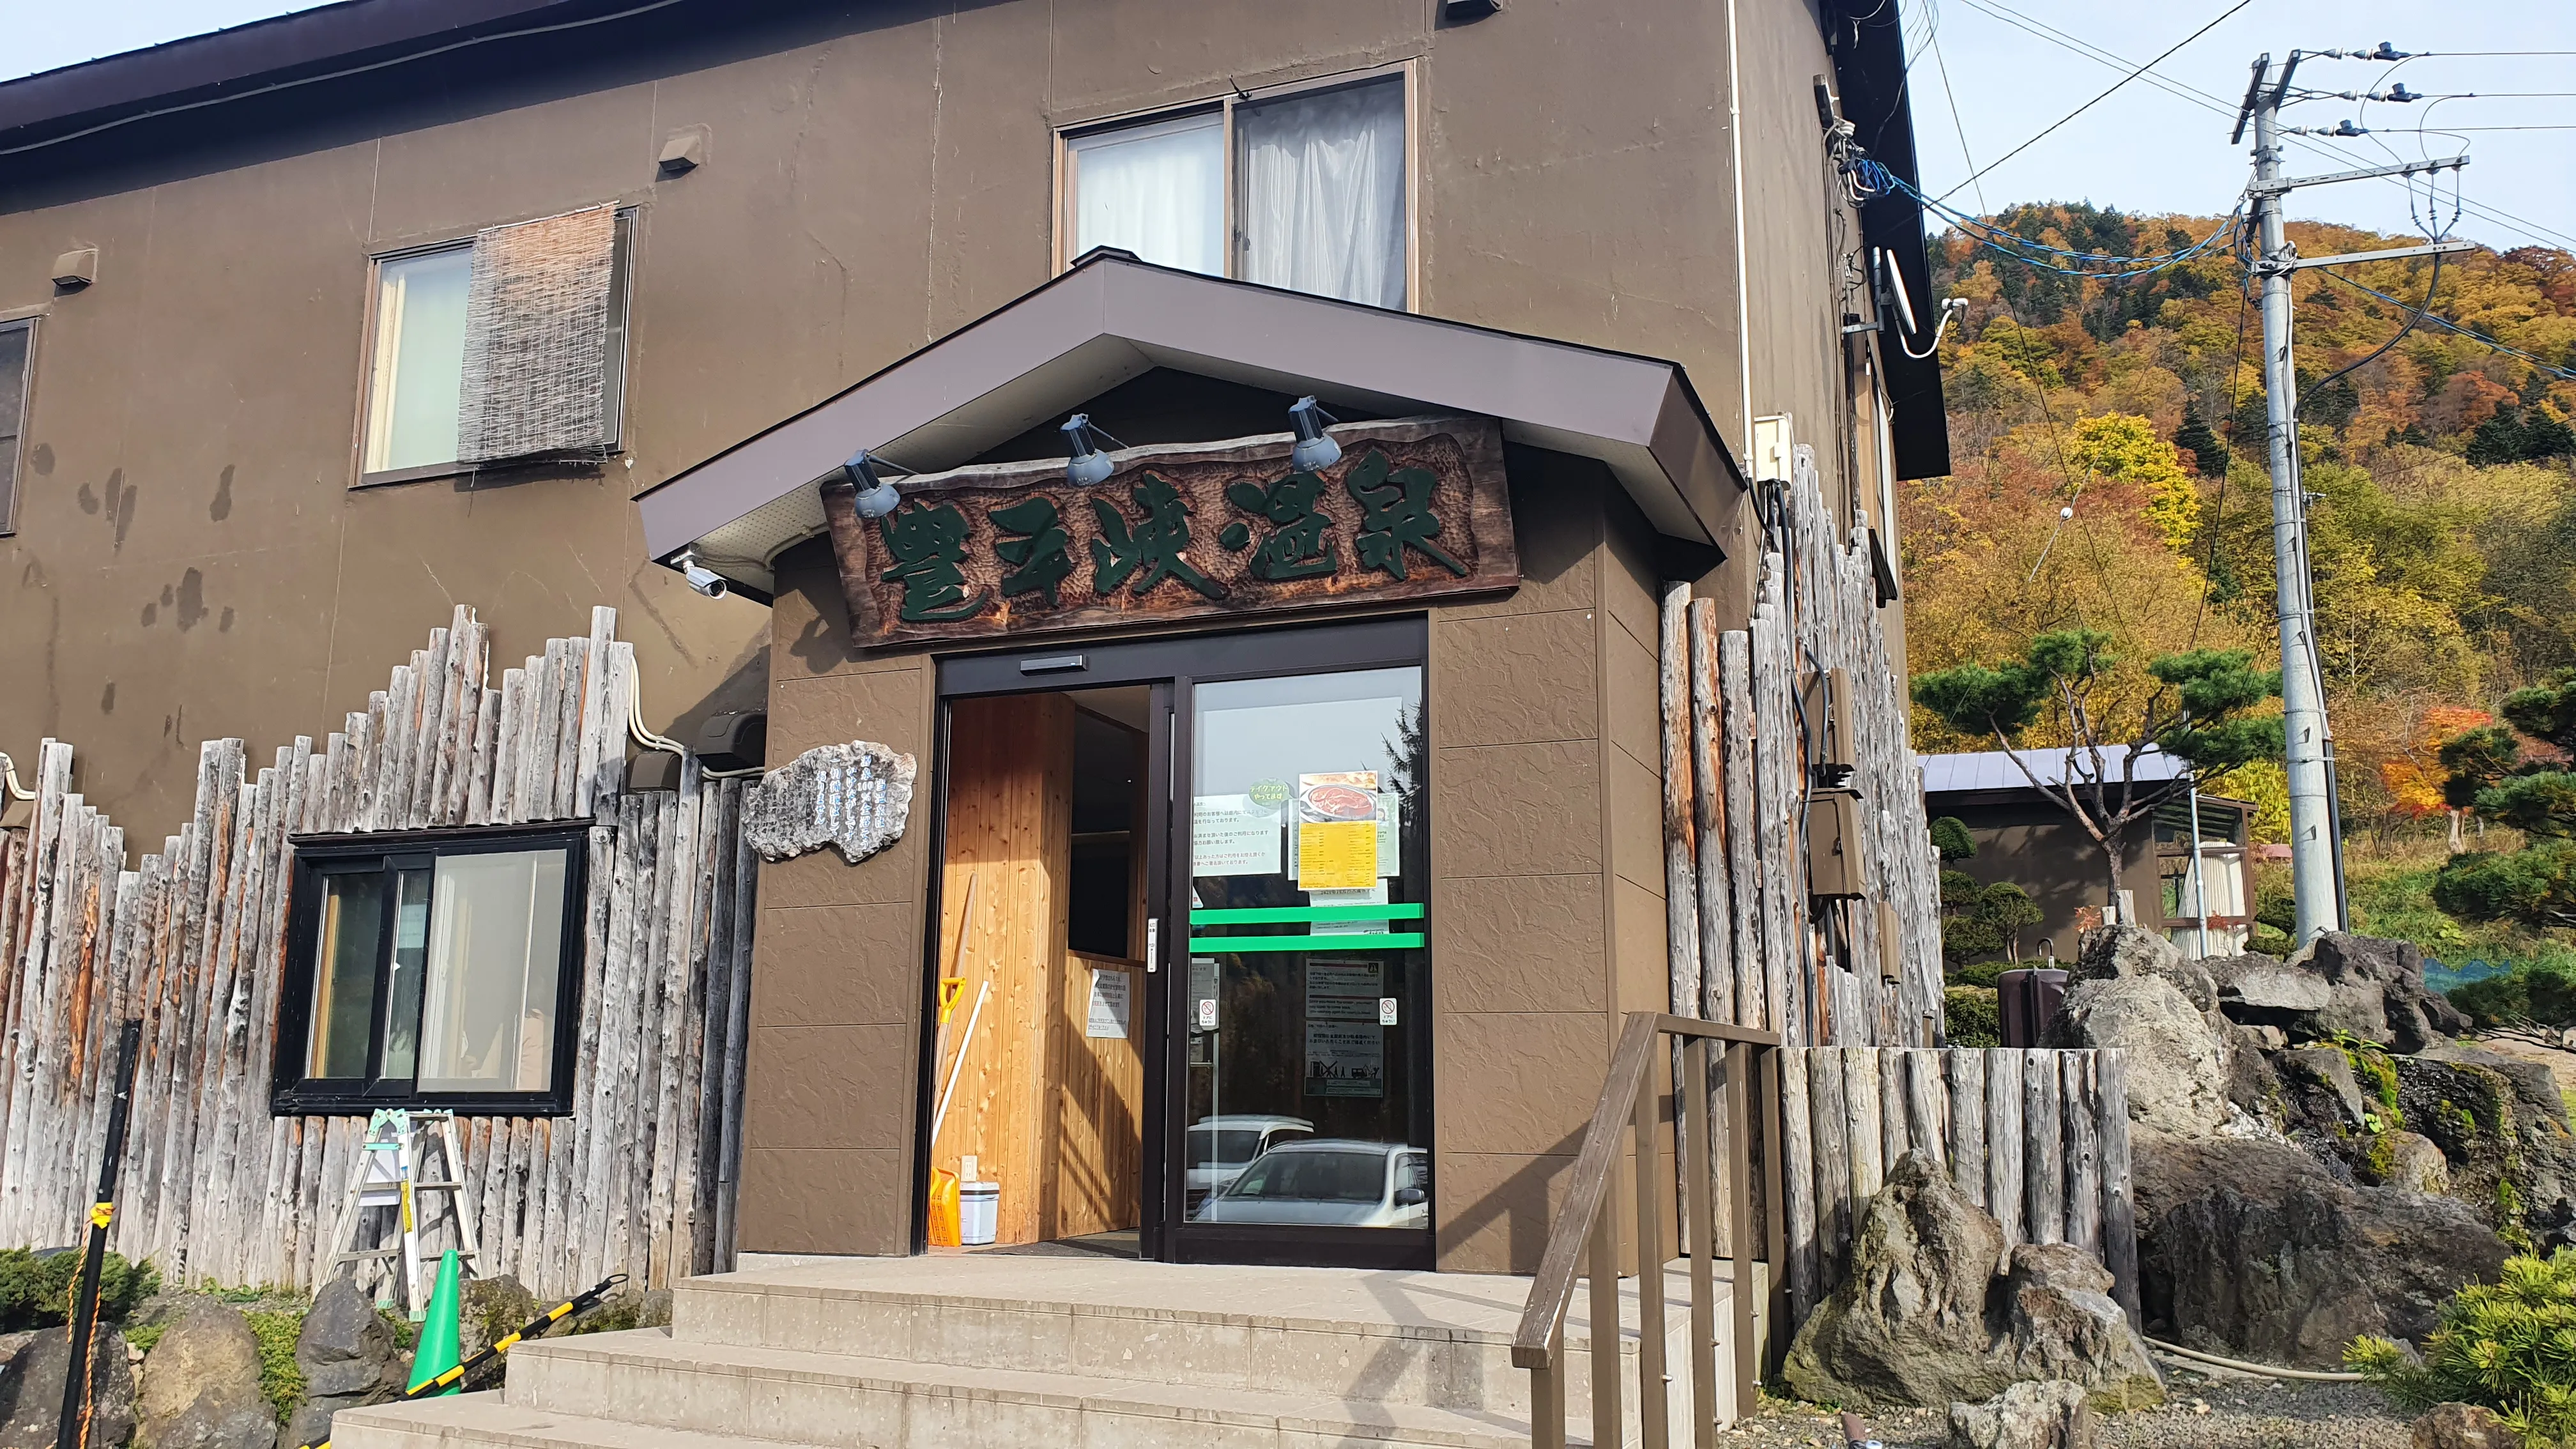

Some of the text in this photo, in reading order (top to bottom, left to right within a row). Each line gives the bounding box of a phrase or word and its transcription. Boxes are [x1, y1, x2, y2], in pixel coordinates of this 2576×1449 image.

[815, 770, 827, 825] おりません
